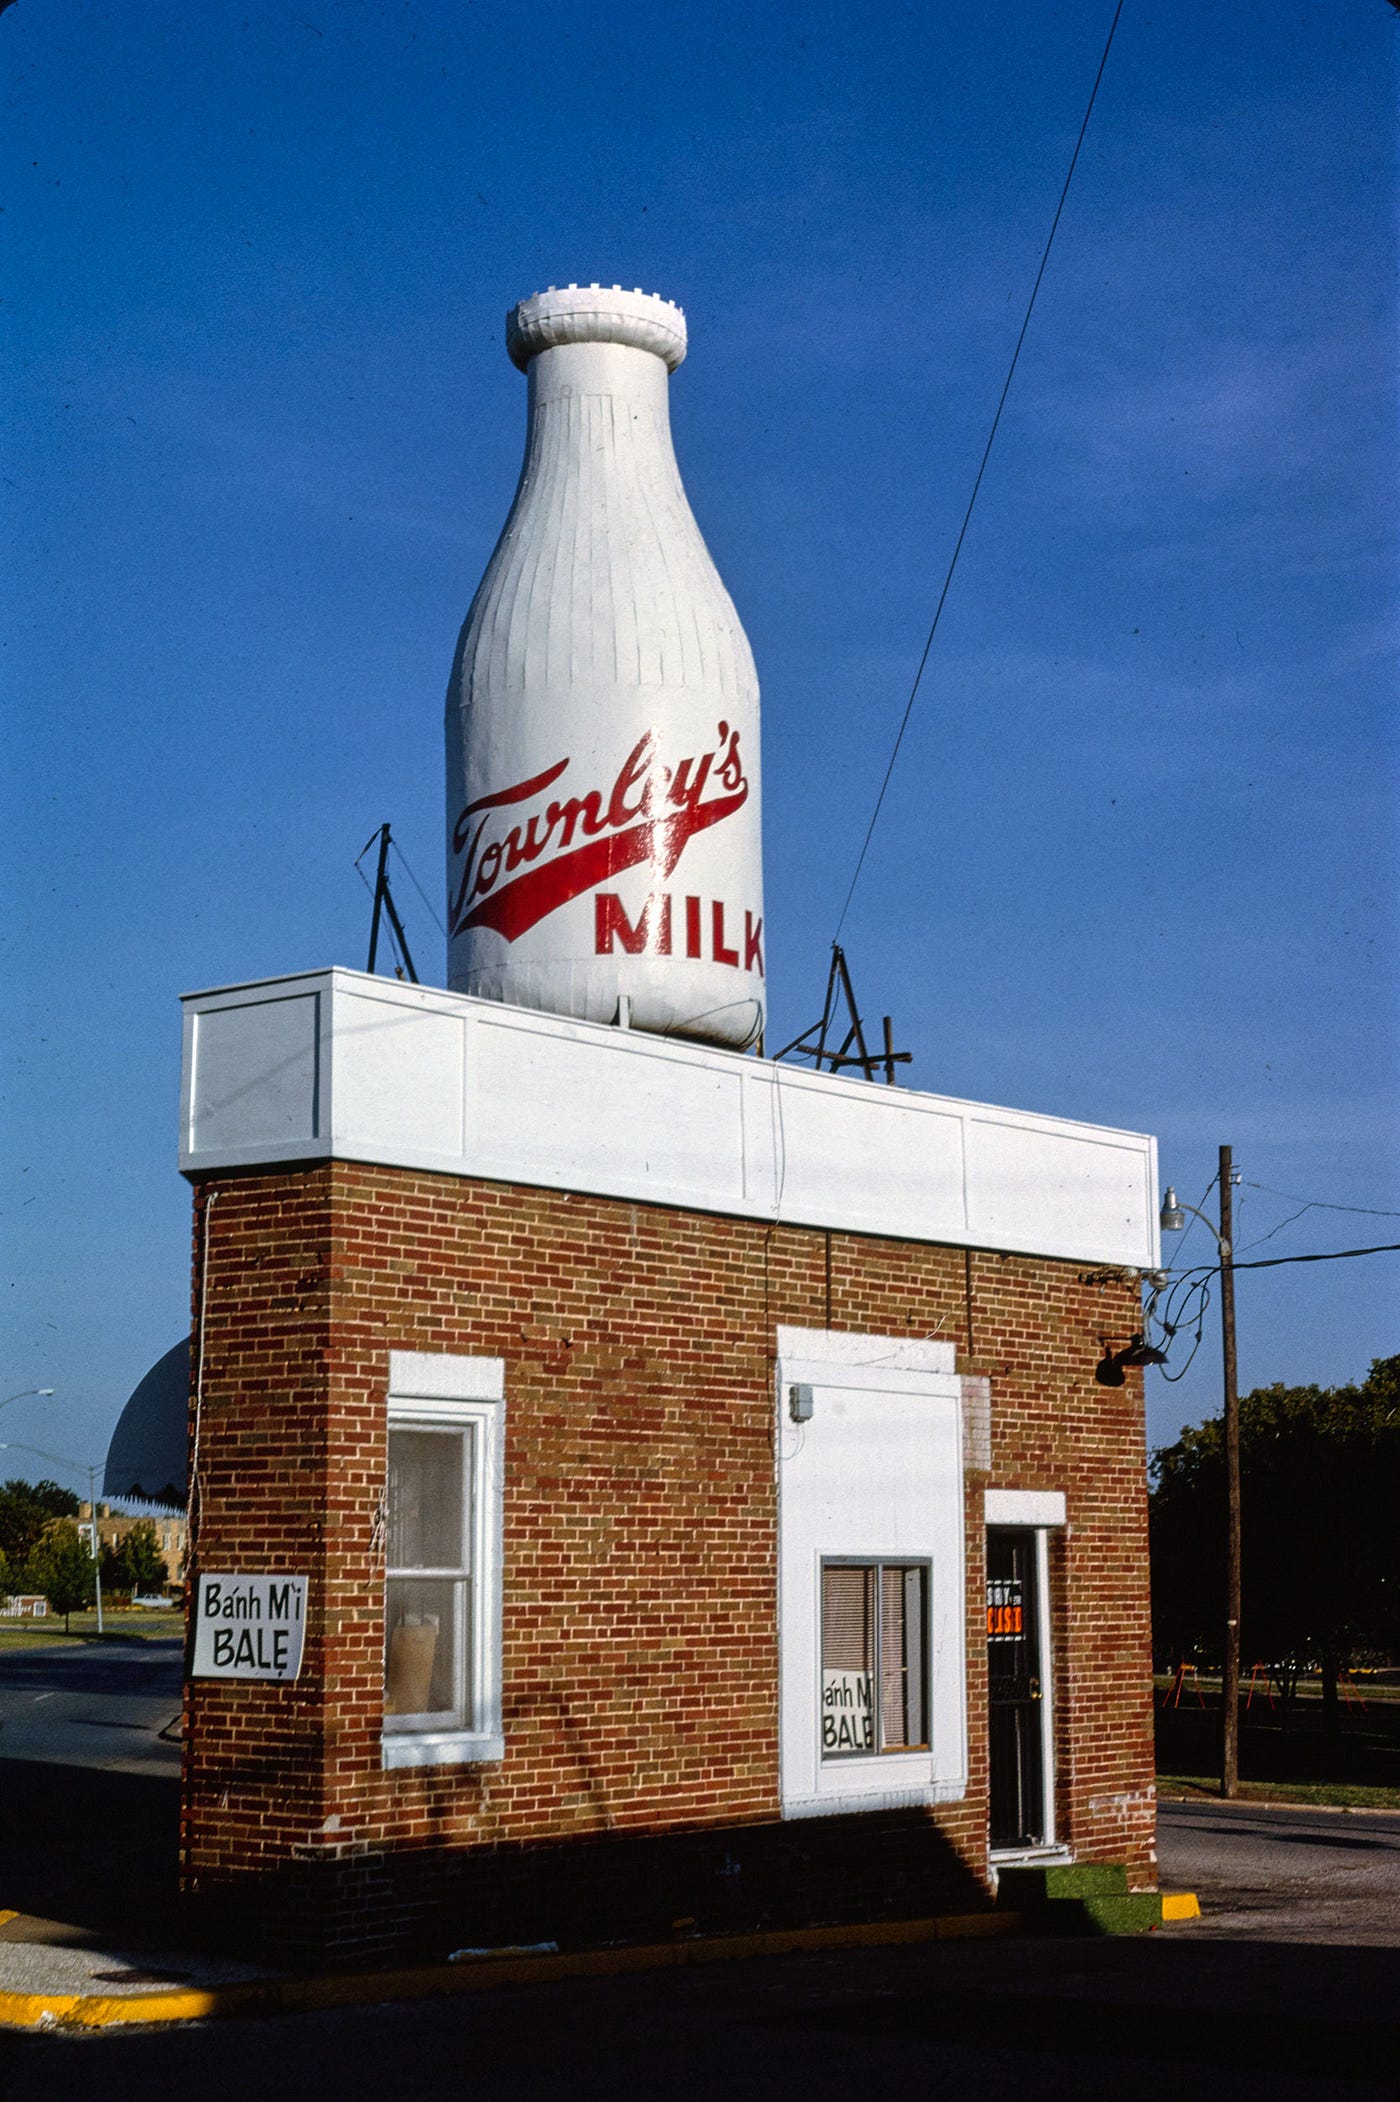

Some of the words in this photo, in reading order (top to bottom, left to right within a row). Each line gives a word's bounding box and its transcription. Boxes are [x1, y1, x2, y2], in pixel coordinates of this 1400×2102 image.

[451, 720, 749, 942] Townley's
[594, 893, 764, 978] MILK
[823, 1677, 853, 1707] ánh
